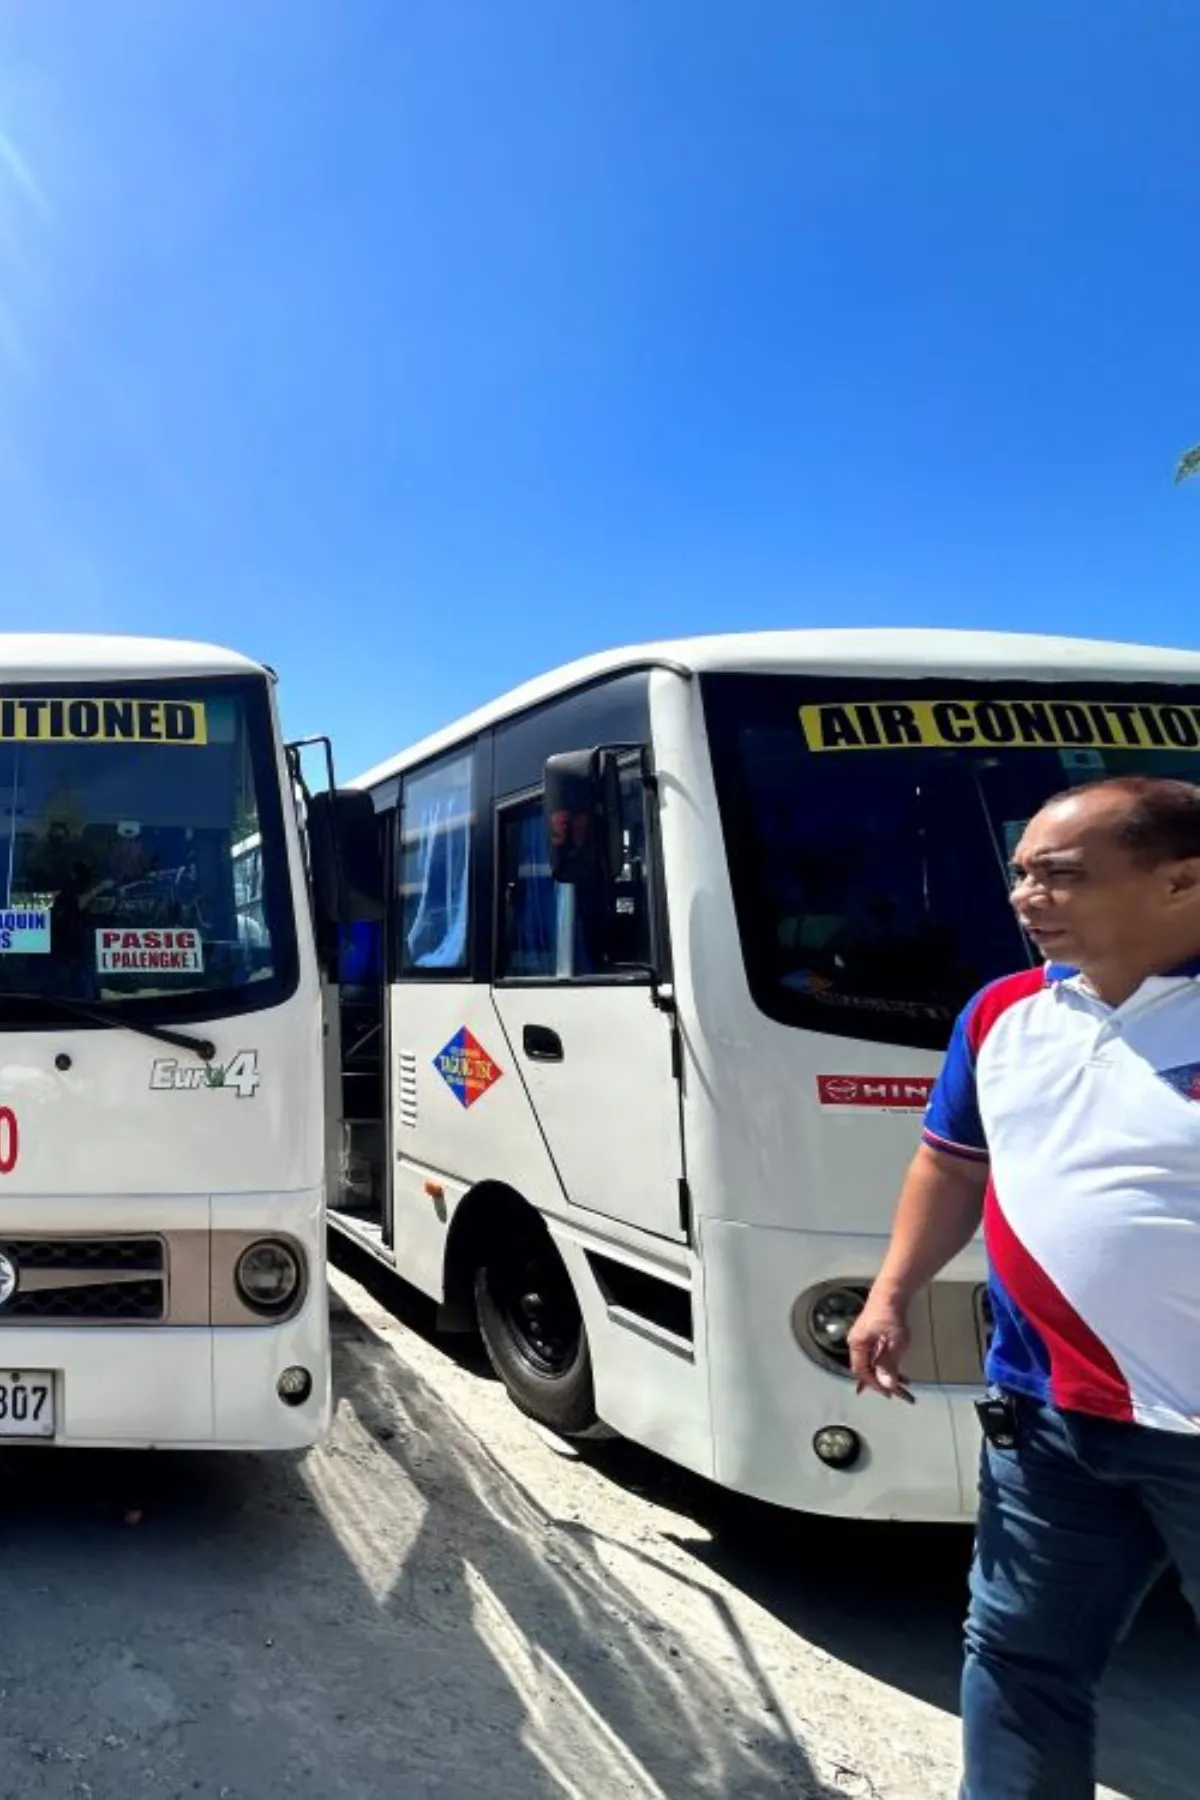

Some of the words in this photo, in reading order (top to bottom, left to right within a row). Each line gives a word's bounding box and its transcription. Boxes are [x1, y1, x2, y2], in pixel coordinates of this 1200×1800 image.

[818, 705, 922, 747] AIR
[930, 703, 1200, 748] CONDITIO
[102, 931, 196, 949] PASIG
